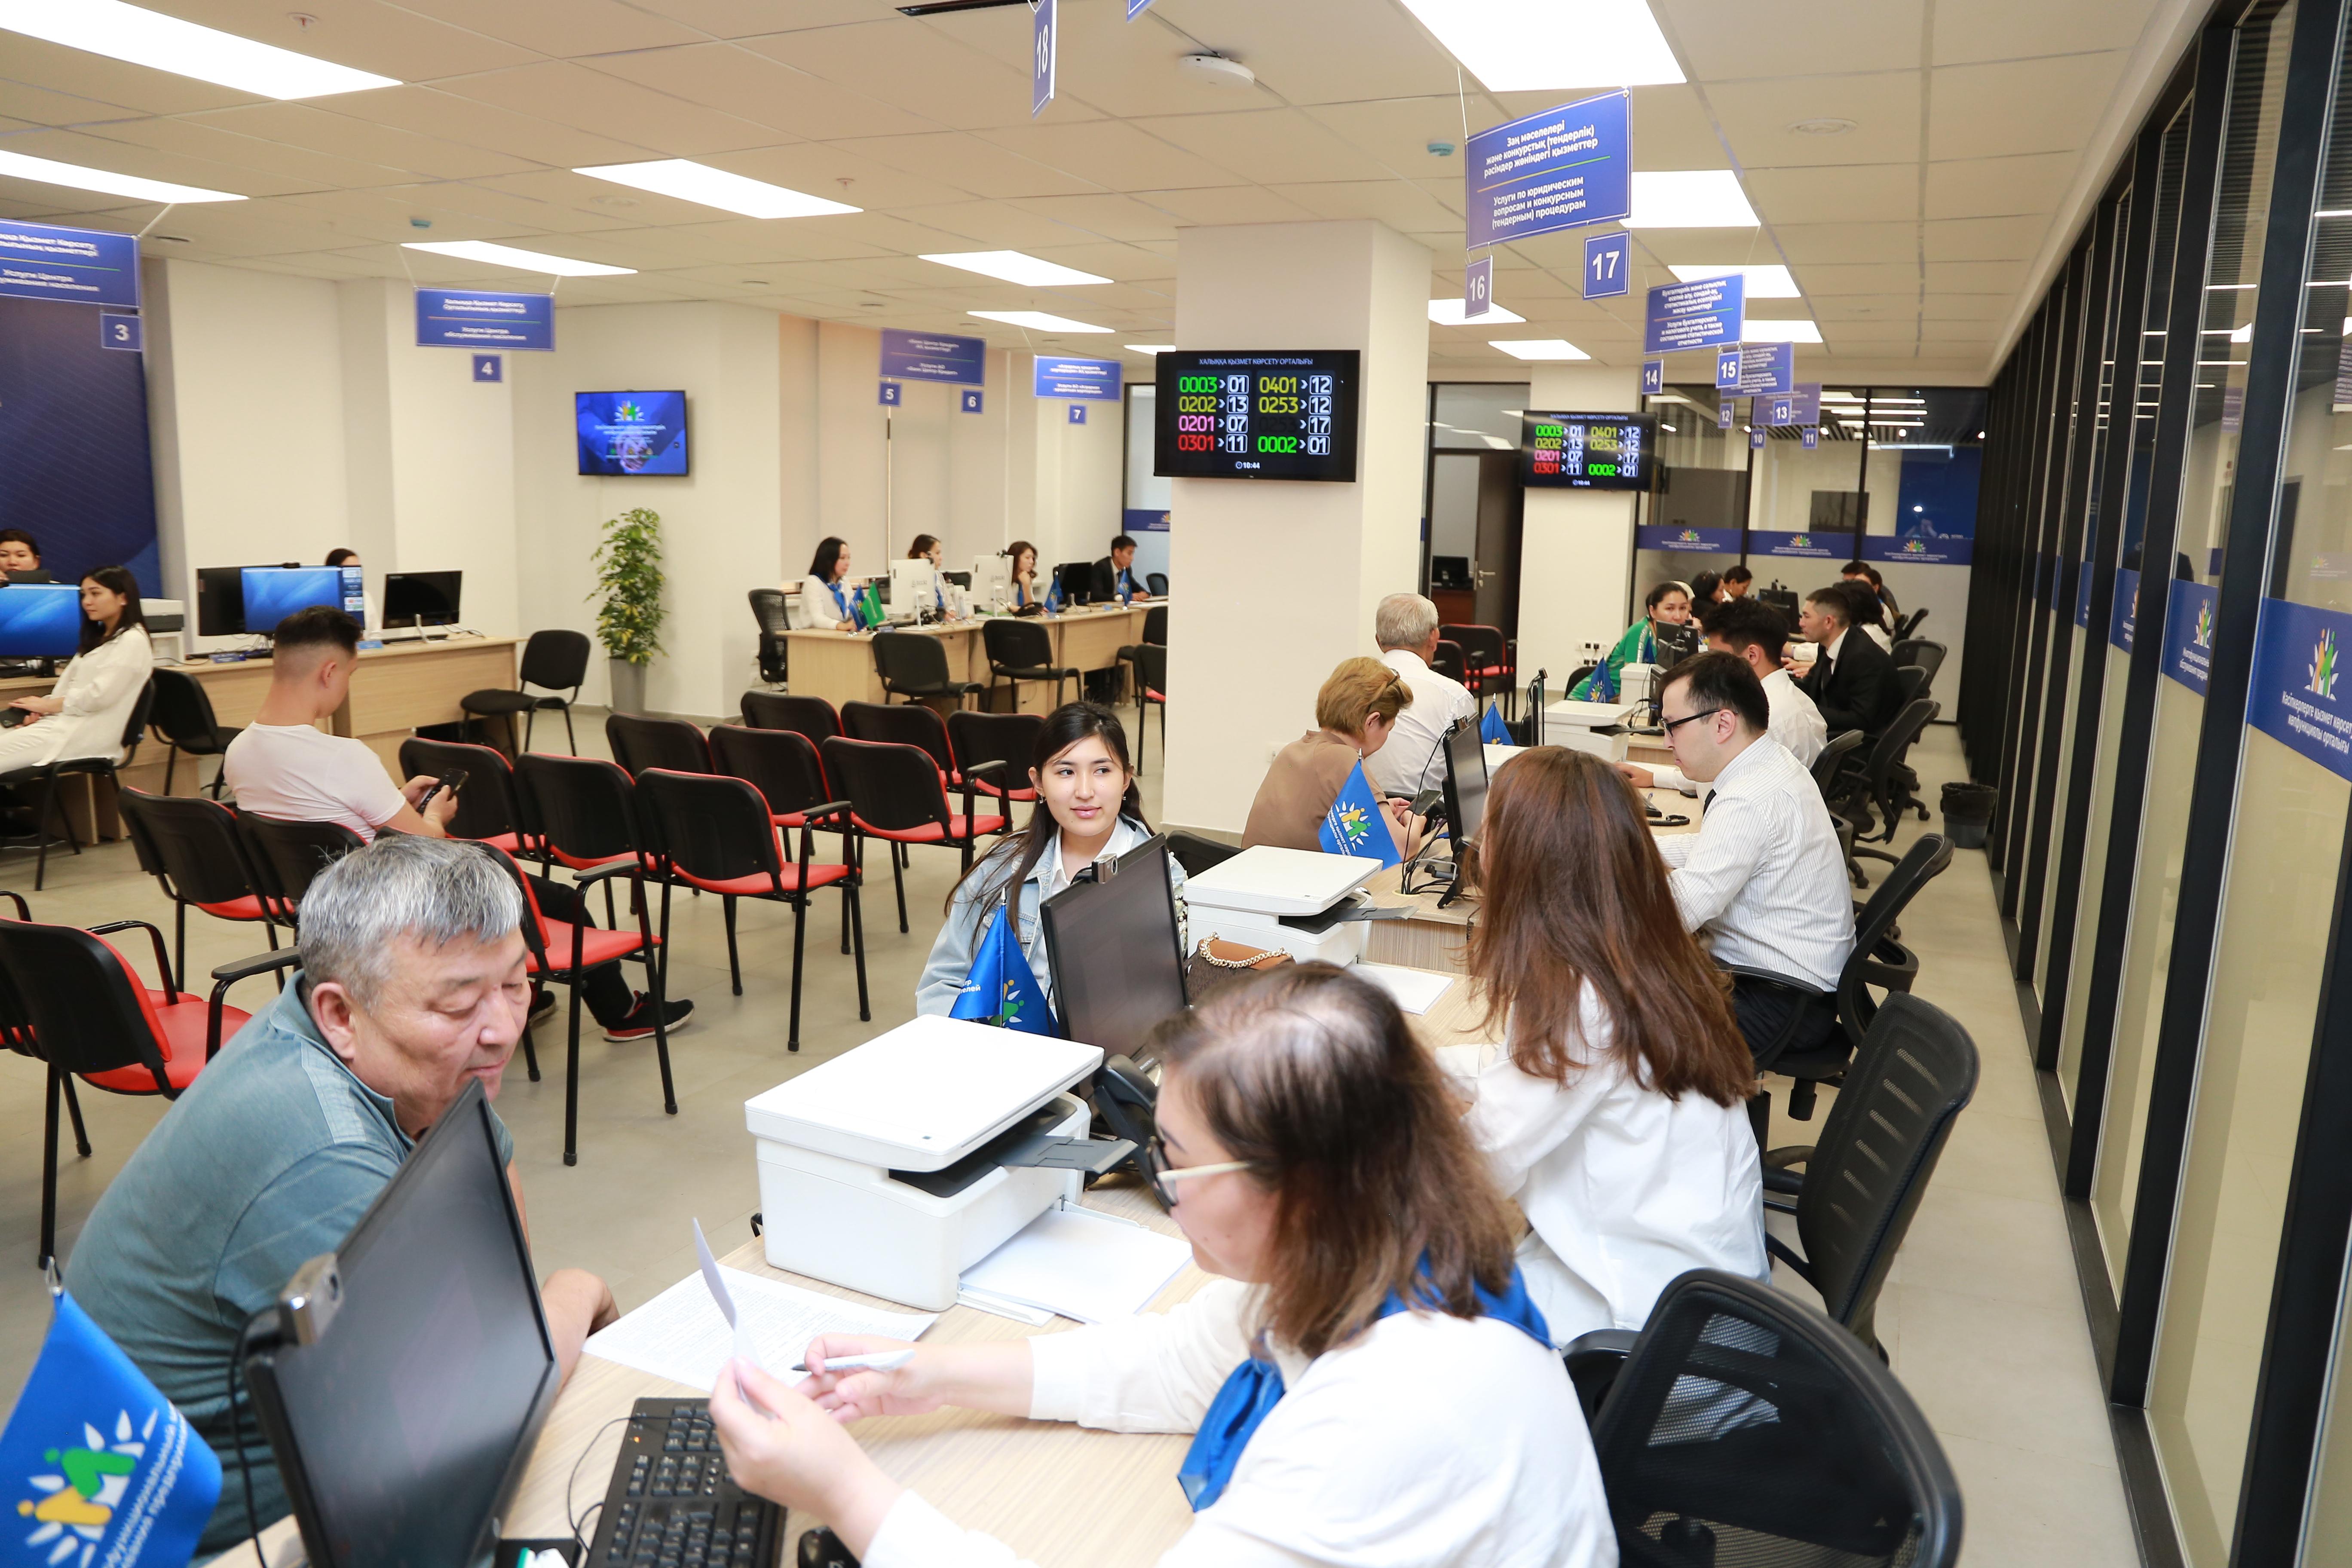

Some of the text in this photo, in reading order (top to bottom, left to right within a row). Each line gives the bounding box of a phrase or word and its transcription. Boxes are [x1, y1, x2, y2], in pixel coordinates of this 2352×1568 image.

[1037, 24, 1048, 79] 18
[1507, 119, 1565, 147] Заң мәселелері
[1486, 124, 1595, 165] және конкурстық (тендерлік)
[1484, 138, 1598, 178] рәсімдер жөніндегі қызметтер
[1494, 177, 1584, 205] Услуги по юридическим
[1494, 188, 1584, 217] вопросам и конкурсным
[1492, 200, 1586, 230] (тендерным) процедурам
[1592, 251, 1620, 281] 17
[1470, 275, 1485, 301] 16
[114, 324, 130, 341] 3
[481, 361, 493, 375] 4
[1721, 361, 1736, 379] 15
[1179, 376, 1245, 393] 0003 01
[1259, 377, 1330, 393] 0401 12
[1645, 370, 1658, 386] 14
[885, 388, 894, 400] 5
[967, 396, 977, 408] 6
[1179, 396, 1247, 412] 0202 13
[1259, 397, 1330, 413] 0253 12
[1074, 409, 1082, 420] 7
[1721, 410, 1730, 422] 12
[1776, 406, 1788, 420] 13
[1179, 415, 1247, 432] 0201 07
[1311, 417, 1329, 433] 17
[1569, 425, 1582, 437] 01
[1591, 426, 1639, 438] 0401 12
[1754, 434, 1763, 444] 10
[1805, 433, 1814, 444] 11
[1178, 435, 1244, 451] 0301 11
[1258, 436, 1326, 453] 0002 01
[1534, 437, 1562, 450] 0202
[1626, 439, 1639, 451] 12
[1534, 450, 1583, 462] 0201 07
[1624, 452, 1637, 464] 17
[1567, 463, 1580, 475] 11
[1588, 463, 1635, 477] 0002 01
[2314, 707, 2334, 726] қызмет
[2323, 731, 2350, 754] орталығы
